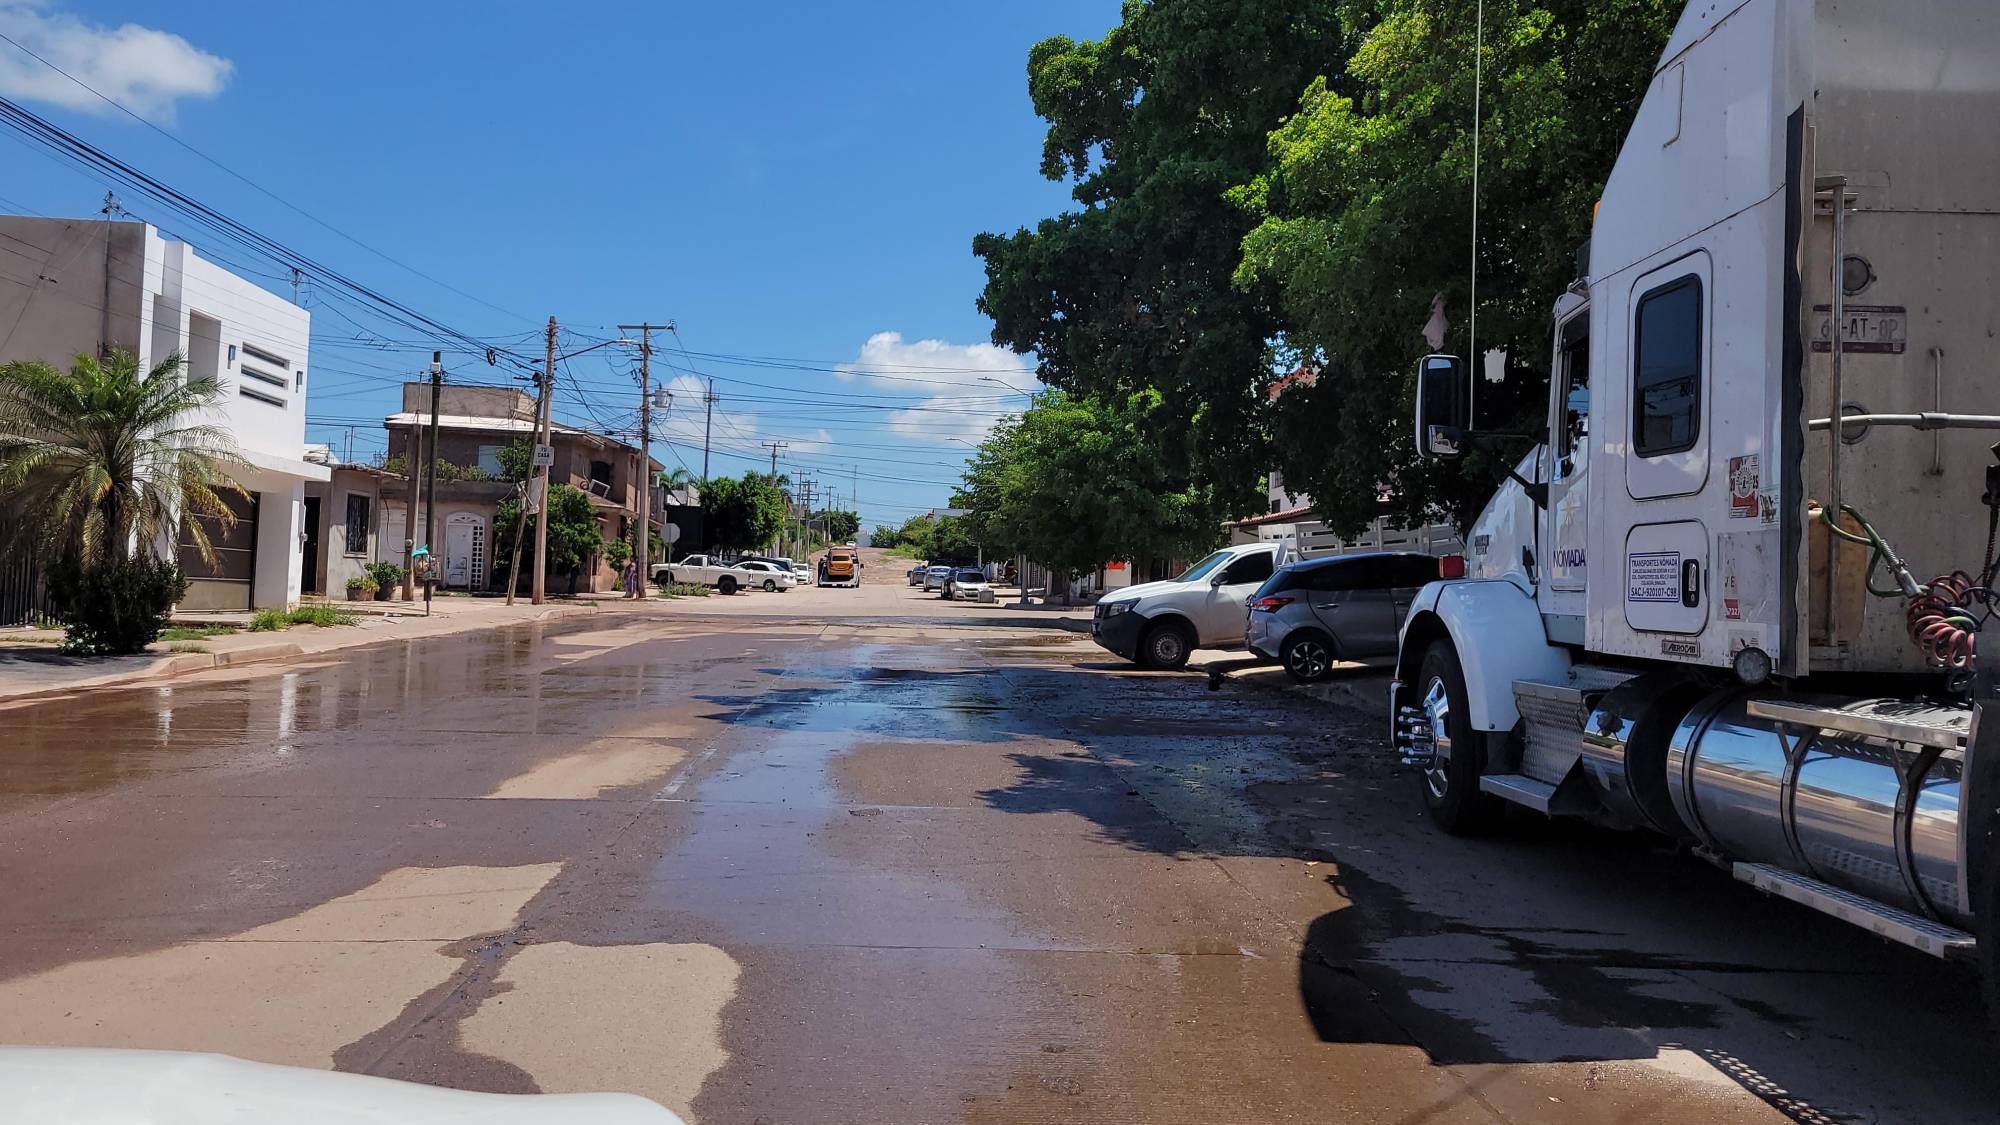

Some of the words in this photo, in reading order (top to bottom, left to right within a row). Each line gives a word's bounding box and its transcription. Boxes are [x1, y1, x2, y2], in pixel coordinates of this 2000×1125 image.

[1553, 546, 1586, 567] NÓMADA
[1632, 559, 1659, 567] TRANSPORTES
[1668, 643, 1696, 654] AEROCAB
